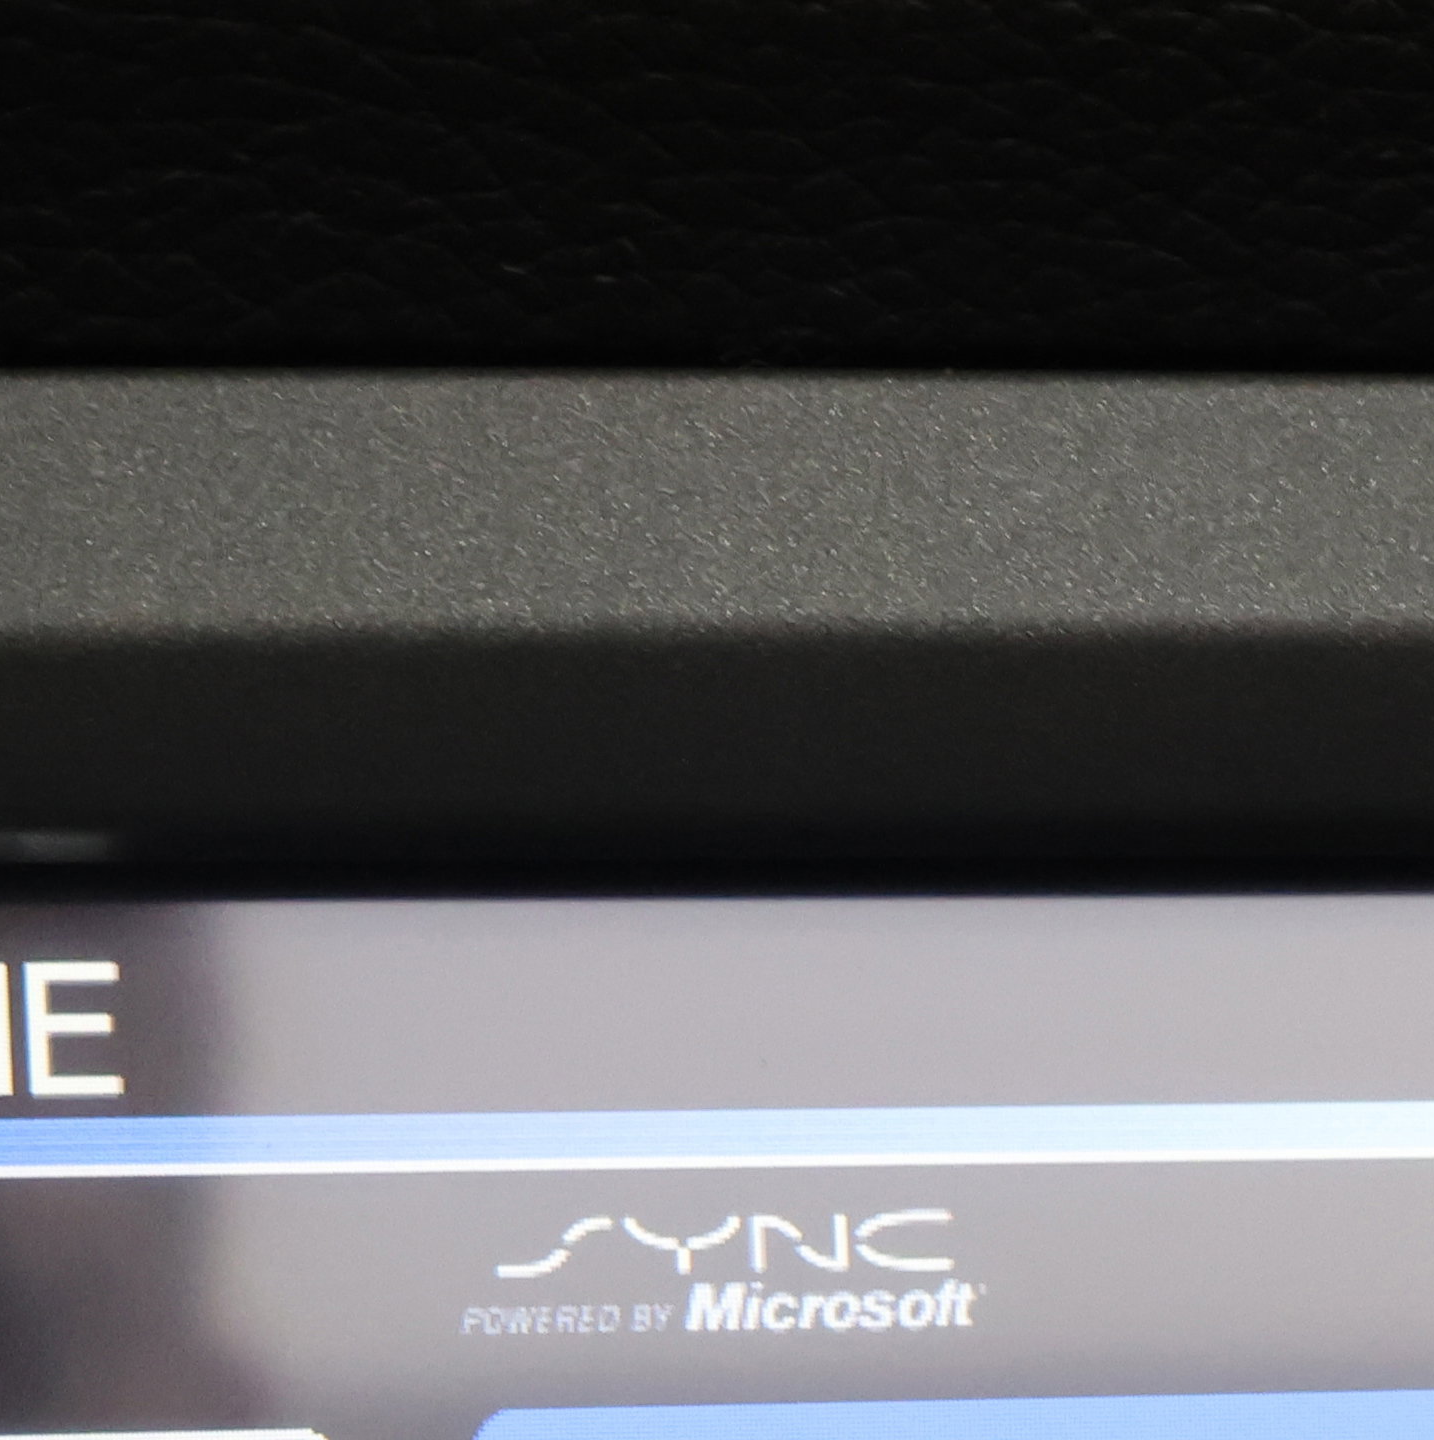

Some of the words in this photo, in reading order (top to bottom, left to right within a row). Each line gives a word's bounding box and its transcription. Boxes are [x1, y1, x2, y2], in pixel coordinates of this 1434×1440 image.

[495, 1208, 954, 1278] SYNC
[460, 1303, 621, 1335] POWERED
[632, 1303, 674, 1333] BY
[685, 1279, 977, 1331] Microsoft
